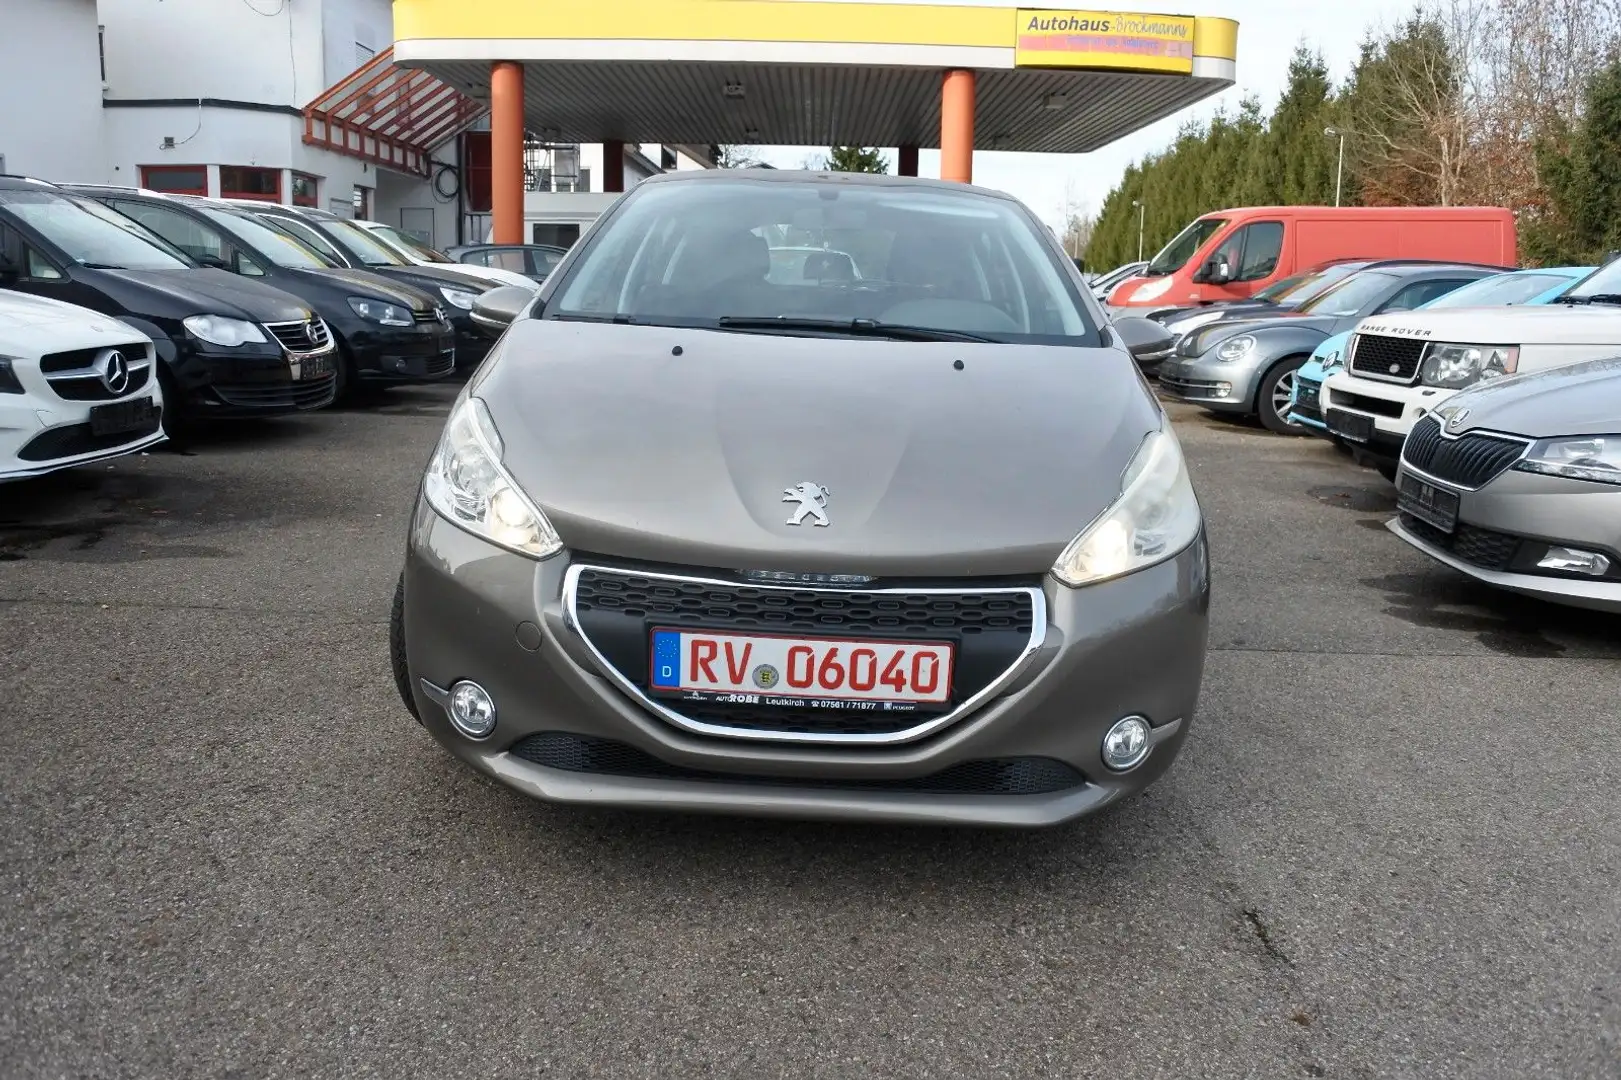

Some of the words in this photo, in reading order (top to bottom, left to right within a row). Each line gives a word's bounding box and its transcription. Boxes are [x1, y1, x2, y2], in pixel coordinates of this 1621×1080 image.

[1027, 15, 1110, 32] Autohaus
[1360, 324, 1387, 333] RANGE
[1391, 327, 1432, 337] ROVER
[662, 665, 672, 678] D
[690, 639, 753, 685] RV
[786, 645, 940, 694] 06040
[765, 697, 805, 707] Leutkirch
[820, 700, 844, 709] 07561
[852, 701, 876, 710] 71877
